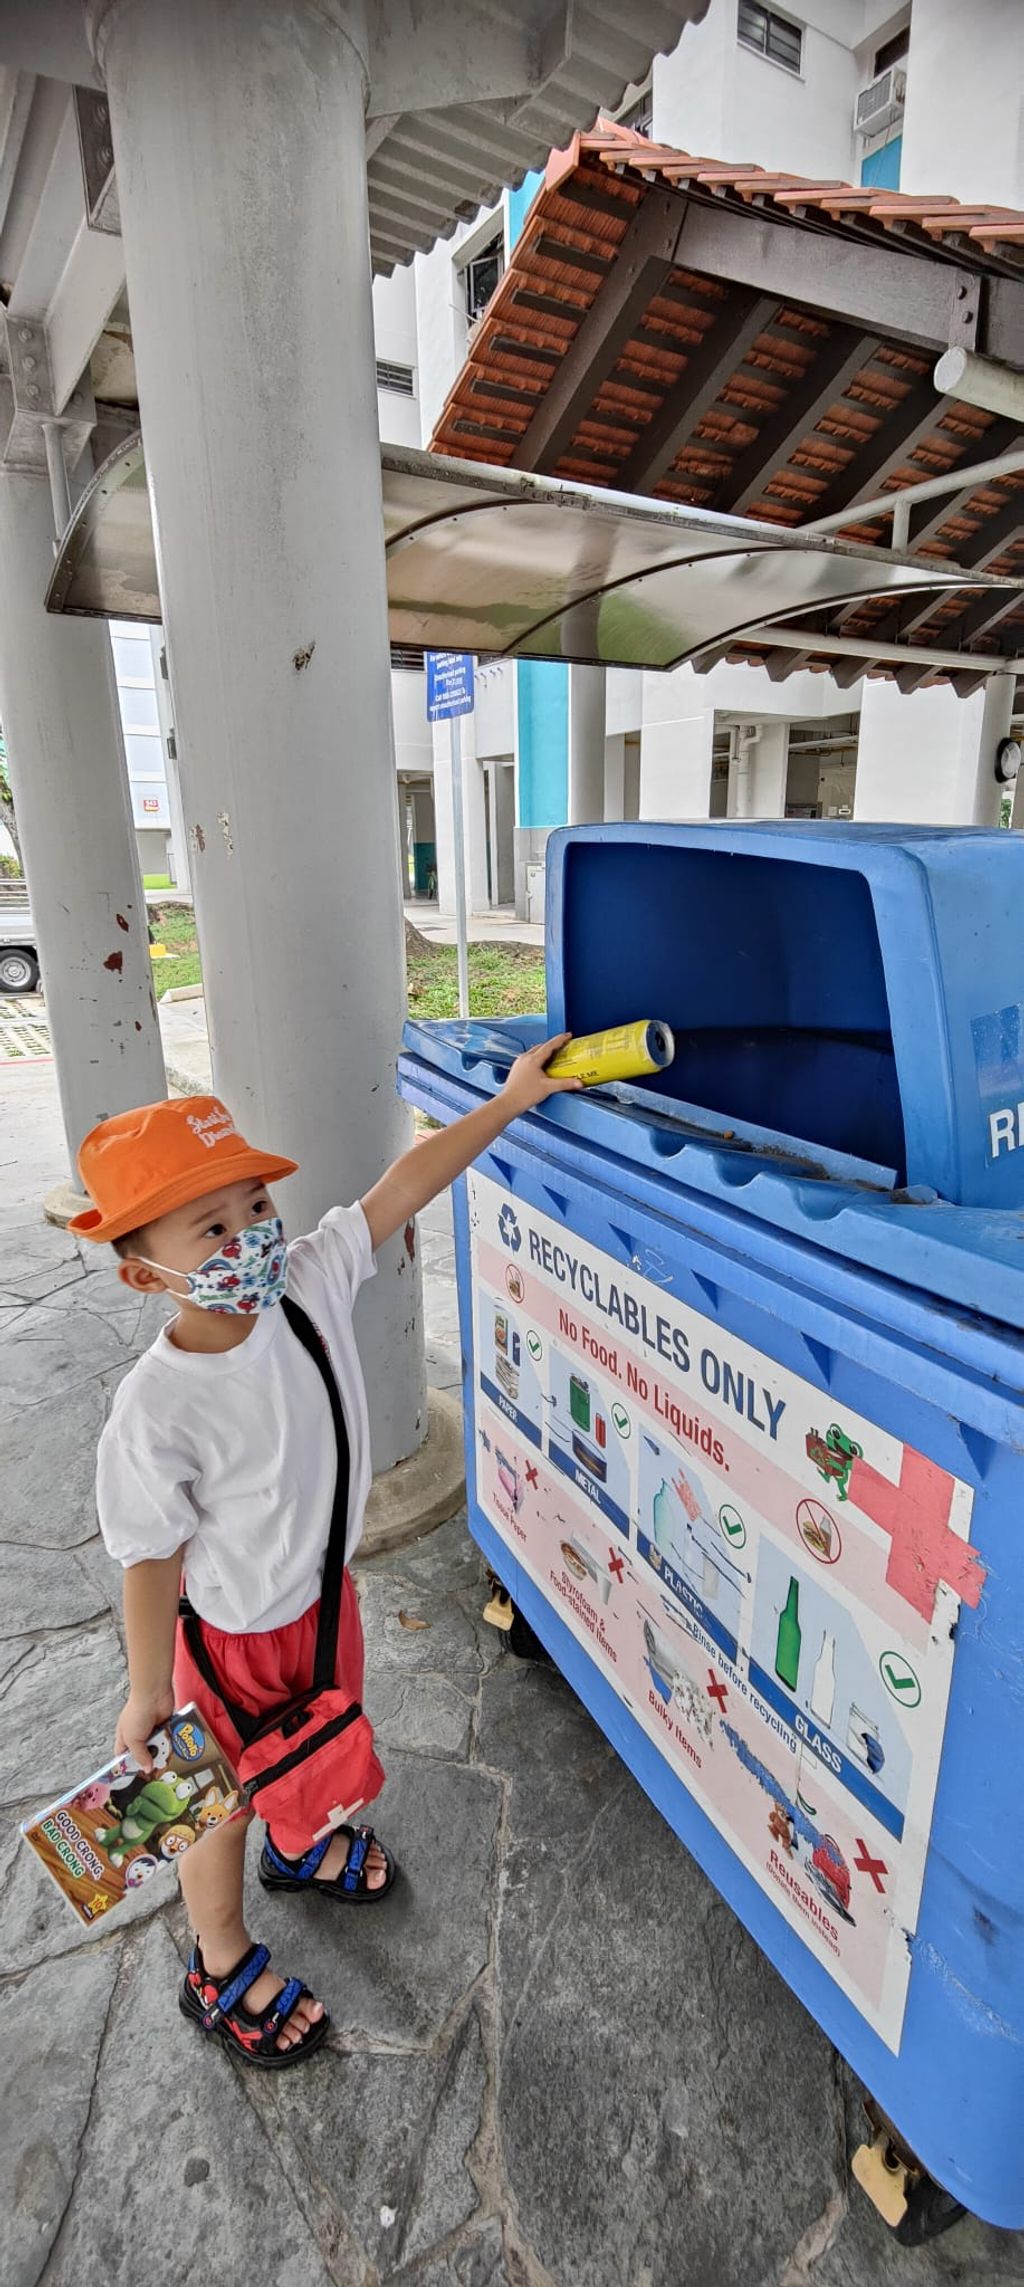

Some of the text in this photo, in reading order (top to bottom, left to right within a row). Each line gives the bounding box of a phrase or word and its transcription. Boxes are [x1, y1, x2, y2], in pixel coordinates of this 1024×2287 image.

[528, 1228, 786, 1441] RECYCLABLES ONLY
[498, 1396, 518, 1424] PAPER
[559, 1308, 730, 1472] No Food. No Liquids.
[575, 1470, 600, 1503] METAL
[550, 1570, 617, 1663] Food-stained Items
[561, 1571, 606, 1633] Styrofoam &
[664, 1565, 705, 1618] PLASTIC
[648, 1690, 702, 1769] Bulky Items
[718, 1652, 748, 1695] before
[749, 1691, 797, 1754] recycling
[795, 1714, 842, 1774] GLASS
[42, 1819, 85, 1878] BAD CRONG
[56, 1811, 80, 1841] GOOD
[770, 1849, 839, 1941] Reusables
